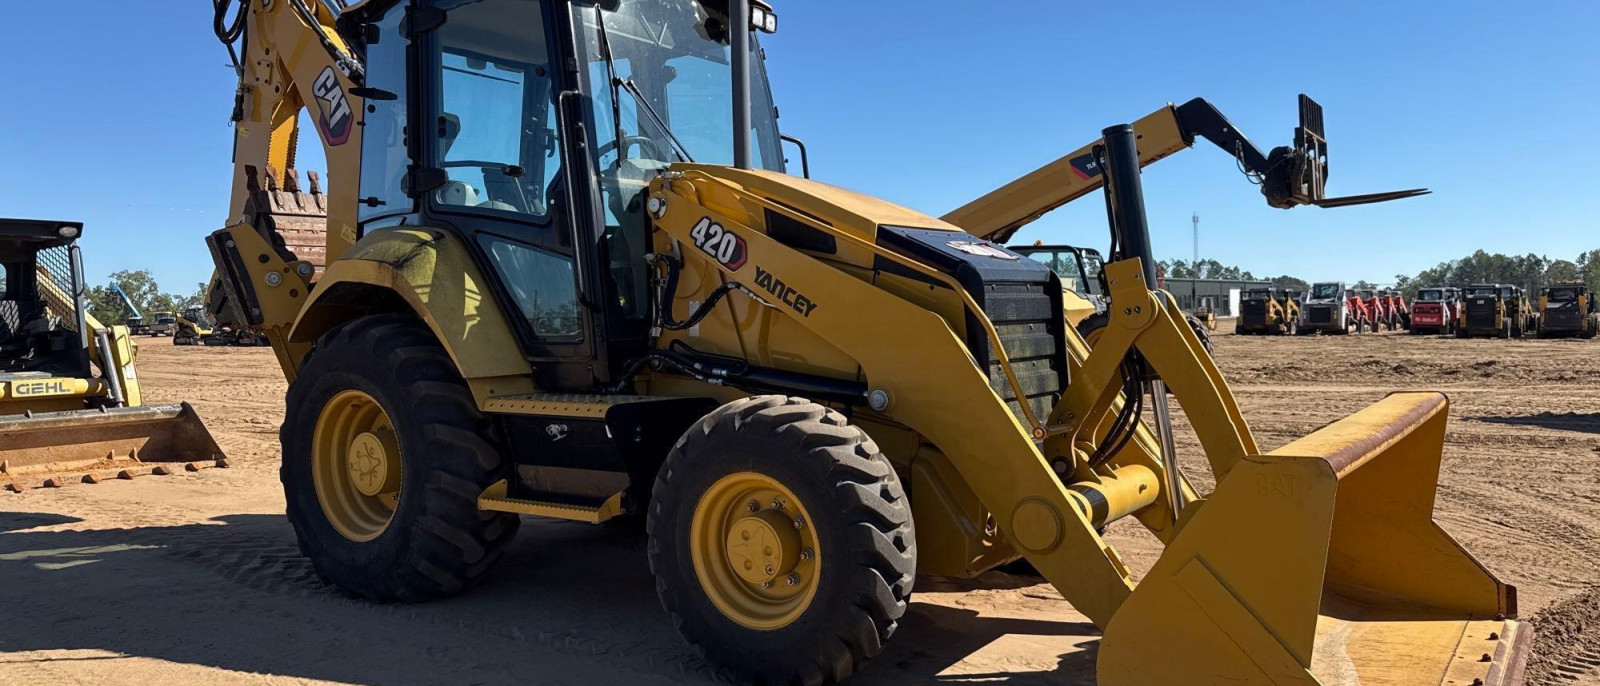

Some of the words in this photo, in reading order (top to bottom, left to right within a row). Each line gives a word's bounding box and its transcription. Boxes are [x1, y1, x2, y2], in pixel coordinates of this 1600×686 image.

[313, 67, 351, 129] CAT
[1086, 157, 1105, 170] TL9C
[691, 217, 737, 264] 420
[753, 265, 817, 317] YANCEY
[15, 381, 68, 395] GEHL
